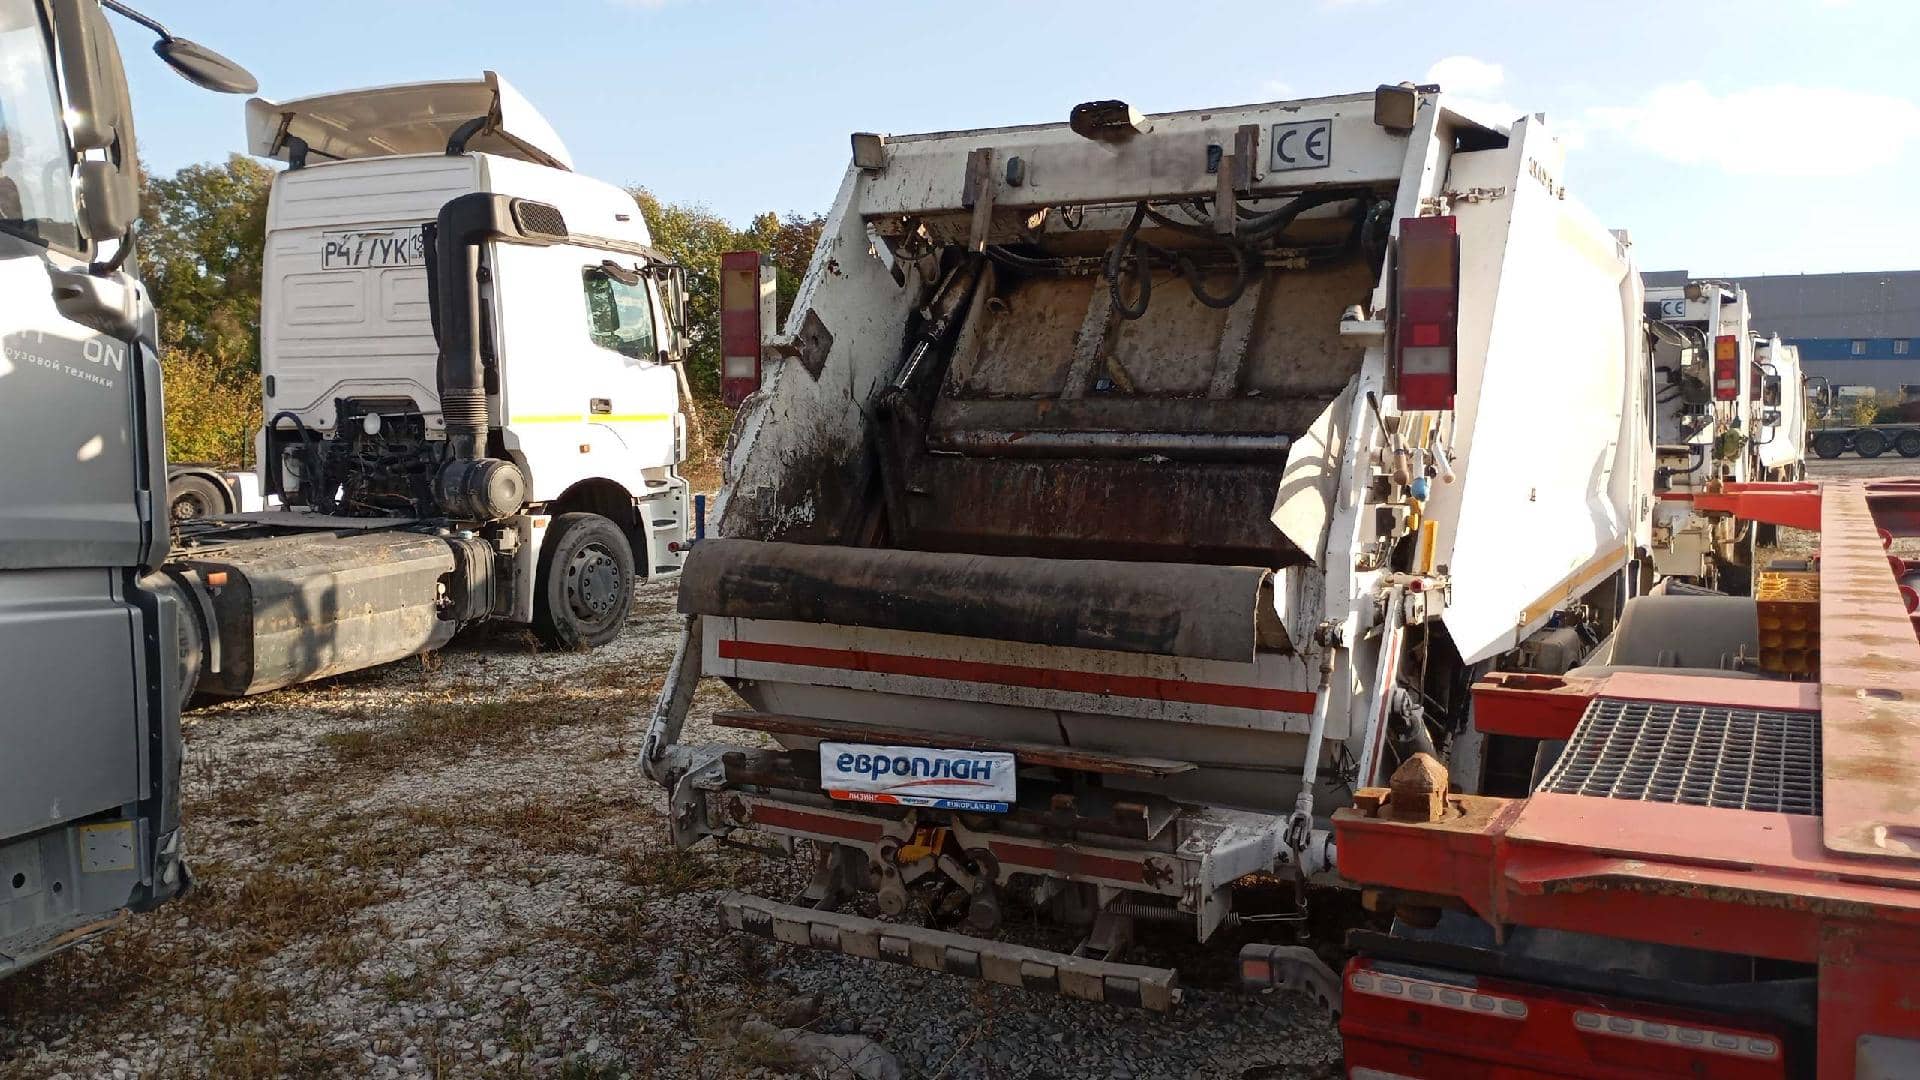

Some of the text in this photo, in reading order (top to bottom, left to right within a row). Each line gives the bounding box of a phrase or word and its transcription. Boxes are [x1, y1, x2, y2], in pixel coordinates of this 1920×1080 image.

[1277, 126, 1326, 163] CE
[1663, 302, 1683, 315] CE
[4, 347, 113, 388] рузовой техники
[836, 753, 993, 780] европлан
